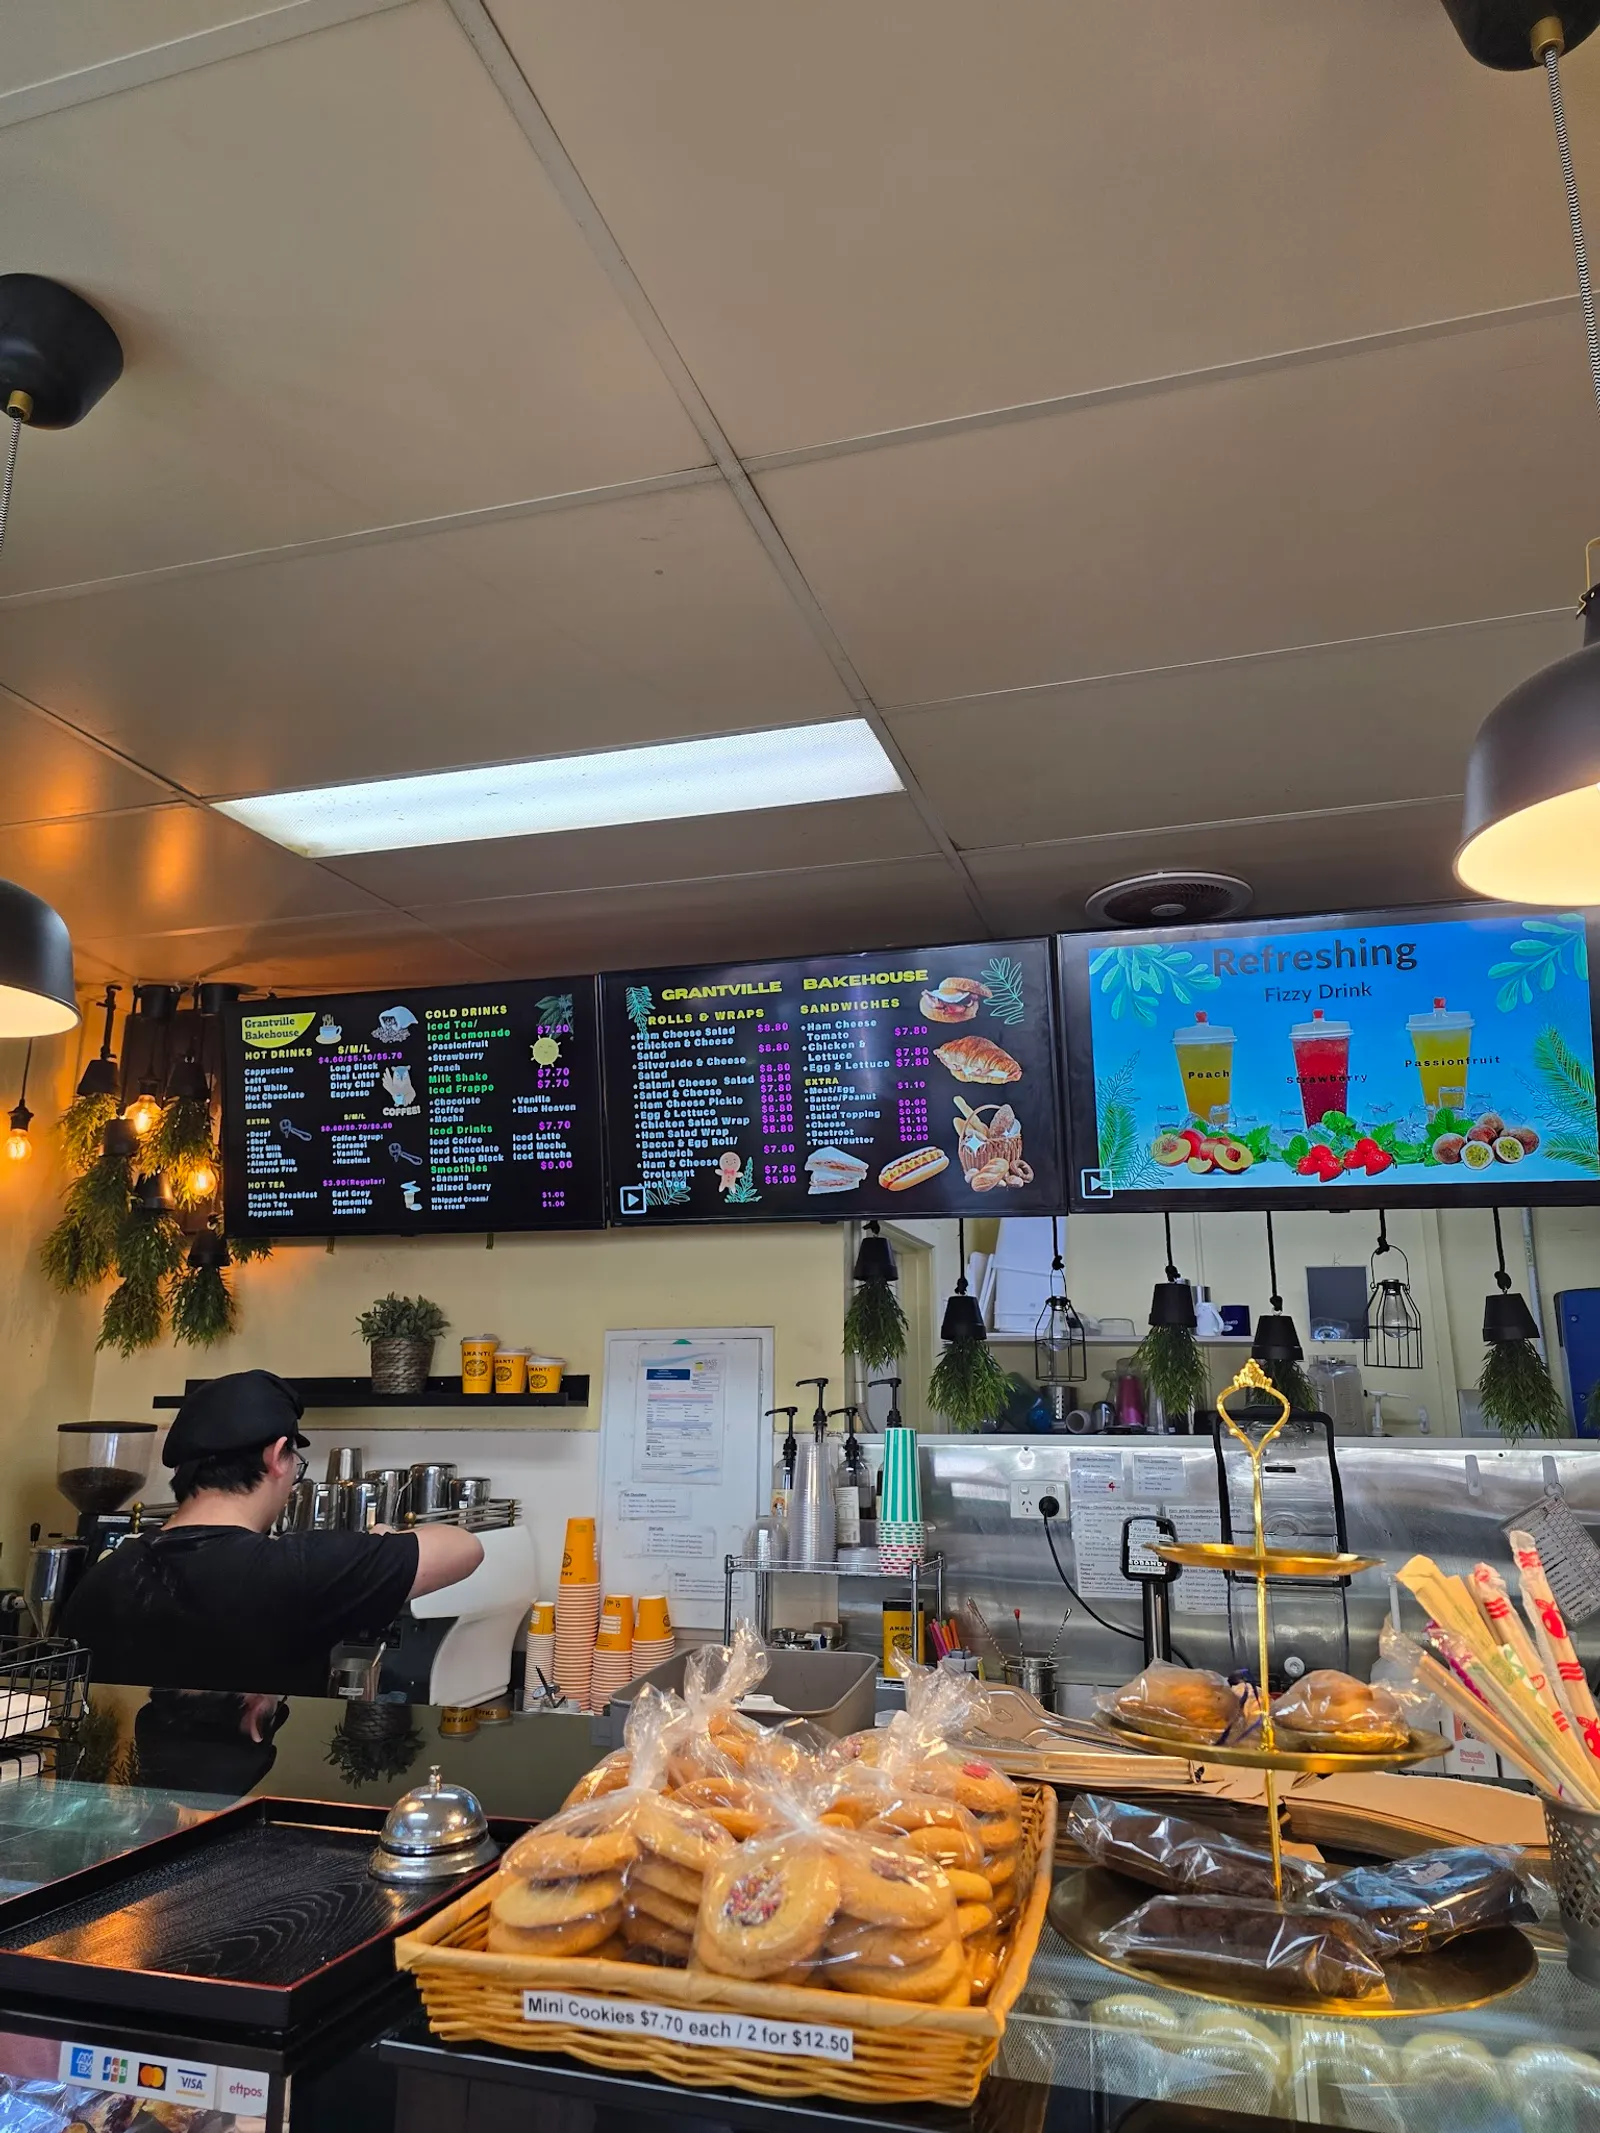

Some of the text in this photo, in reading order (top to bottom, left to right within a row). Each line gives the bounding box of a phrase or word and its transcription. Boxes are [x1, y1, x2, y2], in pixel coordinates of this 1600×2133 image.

[1212, 936, 1418, 977] Refreshing
[662, 969, 929, 1001] GRANTVILLE BAKEHOUSE
[1264, 982, 1372, 1003] Fizzy Drink
[425, 1005, 507, 1019] COLD DRINKS
[800, 998, 900, 1014] SANDWICHES
[244, 1017, 295, 1028] Grantville
[648, 1009, 764, 1025] ROLLS & WRAPS
[427, 1021, 450, 1030] Iced
[636, 1022, 788, 1040] Ham Cheese Salad $8.80
[807, 1019, 876, 1031] Ham Cheese
[244, 1030, 299, 1040] Bakehouse
[427, 1028, 511, 1041] Iced Lemonade
[807, 1026, 927, 1041] Tomato $7.80
[338, 1044, 370, 1054] S/M/L
[433, 1040, 489, 1050] Passionfruit
[637, 1041, 681, 1050] Chicken
[694, 1037, 734, 1047] Cheese
[808, 1041, 855, 1051] Chicken
[245, 1048, 313, 1060] HOT DRINKS
[433, 1052, 484, 1061] Strawberry
[637, 1043, 790, 1060] Salad $8.80
[808, 1047, 929, 1062] Lettuce $7.80
[638, 1058, 693, 1070] Silverside
[707, 1056, 746, 1066] Cheese
[809, 1063, 830, 1072] Egg
[845, 1061, 890, 1070] Lettuce
[896, 1058, 929, 1067] $7.80
[1404, 1055, 1501, 1067] Passionfruit
[429, 1067, 570, 1083] Milk Shake $7.70
[638, 1063, 790, 1080] Salad $8.80
[1188, 1069, 1230, 1080] Peach
[1286, 1074, 1368, 1083] Strawberry
[429, 1079, 569, 1094] Iced Frappe $7.70
[639, 1073, 791, 1090] Salami Cheese Salad $8.80
[805, 1077, 839, 1086] EXTRA
[639, 1090, 669, 1100] Salad
[683, 1088, 722, 1097] Cheese
[760, 1084, 791, 1093] $7.80
[640, 1102, 663, 1110] Ham
[666, 1099, 705, 1108] Cheese
[708, 1096, 743, 1106] Pickle
[640, 1112, 660, 1120] Egg
[674, 1108, 716, 1118] Lettuce
[430, 1121, 571, 1135] Iced Drinks $7.70
[641, 1114, 793, 1130] Chicken Salad Wrap $8.80
[668, 1128, 697, 1137] Salad
[701, 1127, 729, 1137] Wrap
[762, 1124, 794, 1134] $8.80
[642, 1140, 674, 1149] Bacon
[688, 1138, 708, 1148] Egg
[642, 1144, 795, 1159] Sandwich $7.80
[430, 1164, 488, 1174] Smoothies
[643, 1161, 665, 1169] Ham
[679, 1159, 718, 1167] Cheese
[642, 1165, 796, 1179] Croissant $7.80
[528, 1997, 849, 2053] Mini Cookies $7.70 each / 2 for $12.50
[102, 2063, 127, 2076] JCB
[180, 2076, 203, 2090] VISA
